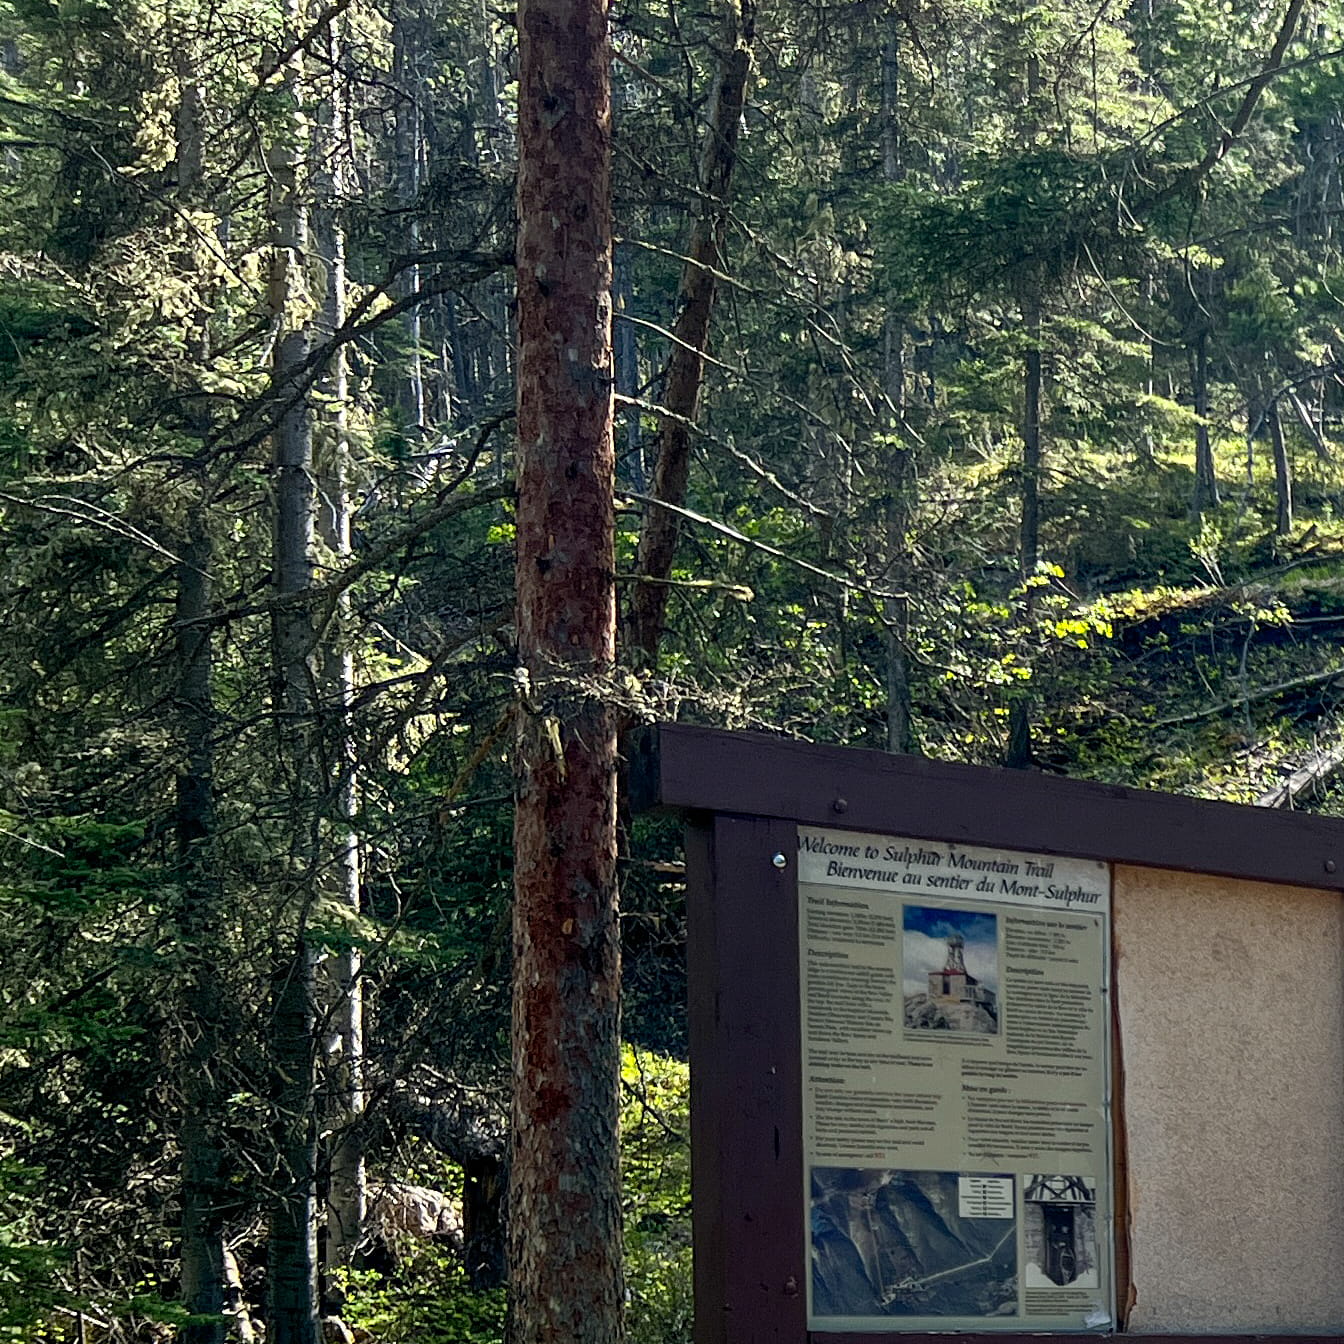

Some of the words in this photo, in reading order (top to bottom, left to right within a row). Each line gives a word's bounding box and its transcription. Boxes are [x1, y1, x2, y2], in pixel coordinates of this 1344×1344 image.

[796, 835, 859, 858] Welcome
[864, 845, 879, 860] to
[883, 845, 944, 869] Sulphur
[949, 852, 1020, 876] Mountain
[1024, 860, 1054, 879] Trail
[826, 860, 898, 884] Bienvenue
[902, 873, 922, 887] au
[926, 873, 972, 892] sentier
[976, 878, 995, 894] du
[999, 878, 1102, 908] Mont-Sulphur
